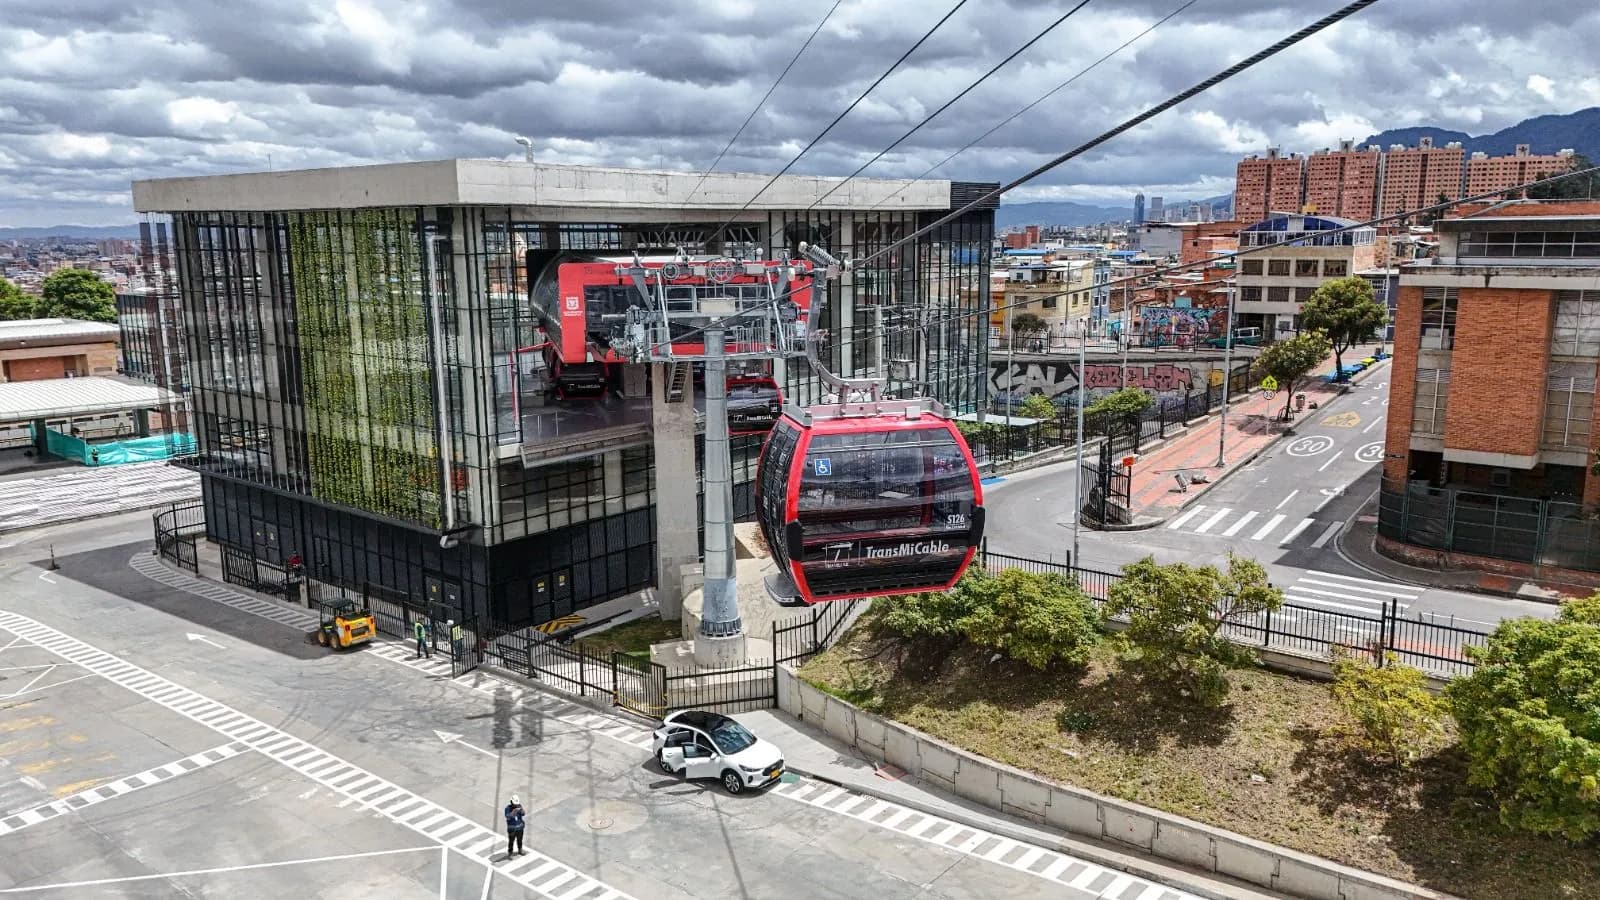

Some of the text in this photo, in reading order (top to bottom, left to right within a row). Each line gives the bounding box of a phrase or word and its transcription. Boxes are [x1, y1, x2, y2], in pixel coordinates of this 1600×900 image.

[1294, 440, 1326, 453] 30
[947, 513, 965, 524] S126
[865, 540, 949, 559] TransMiCable
